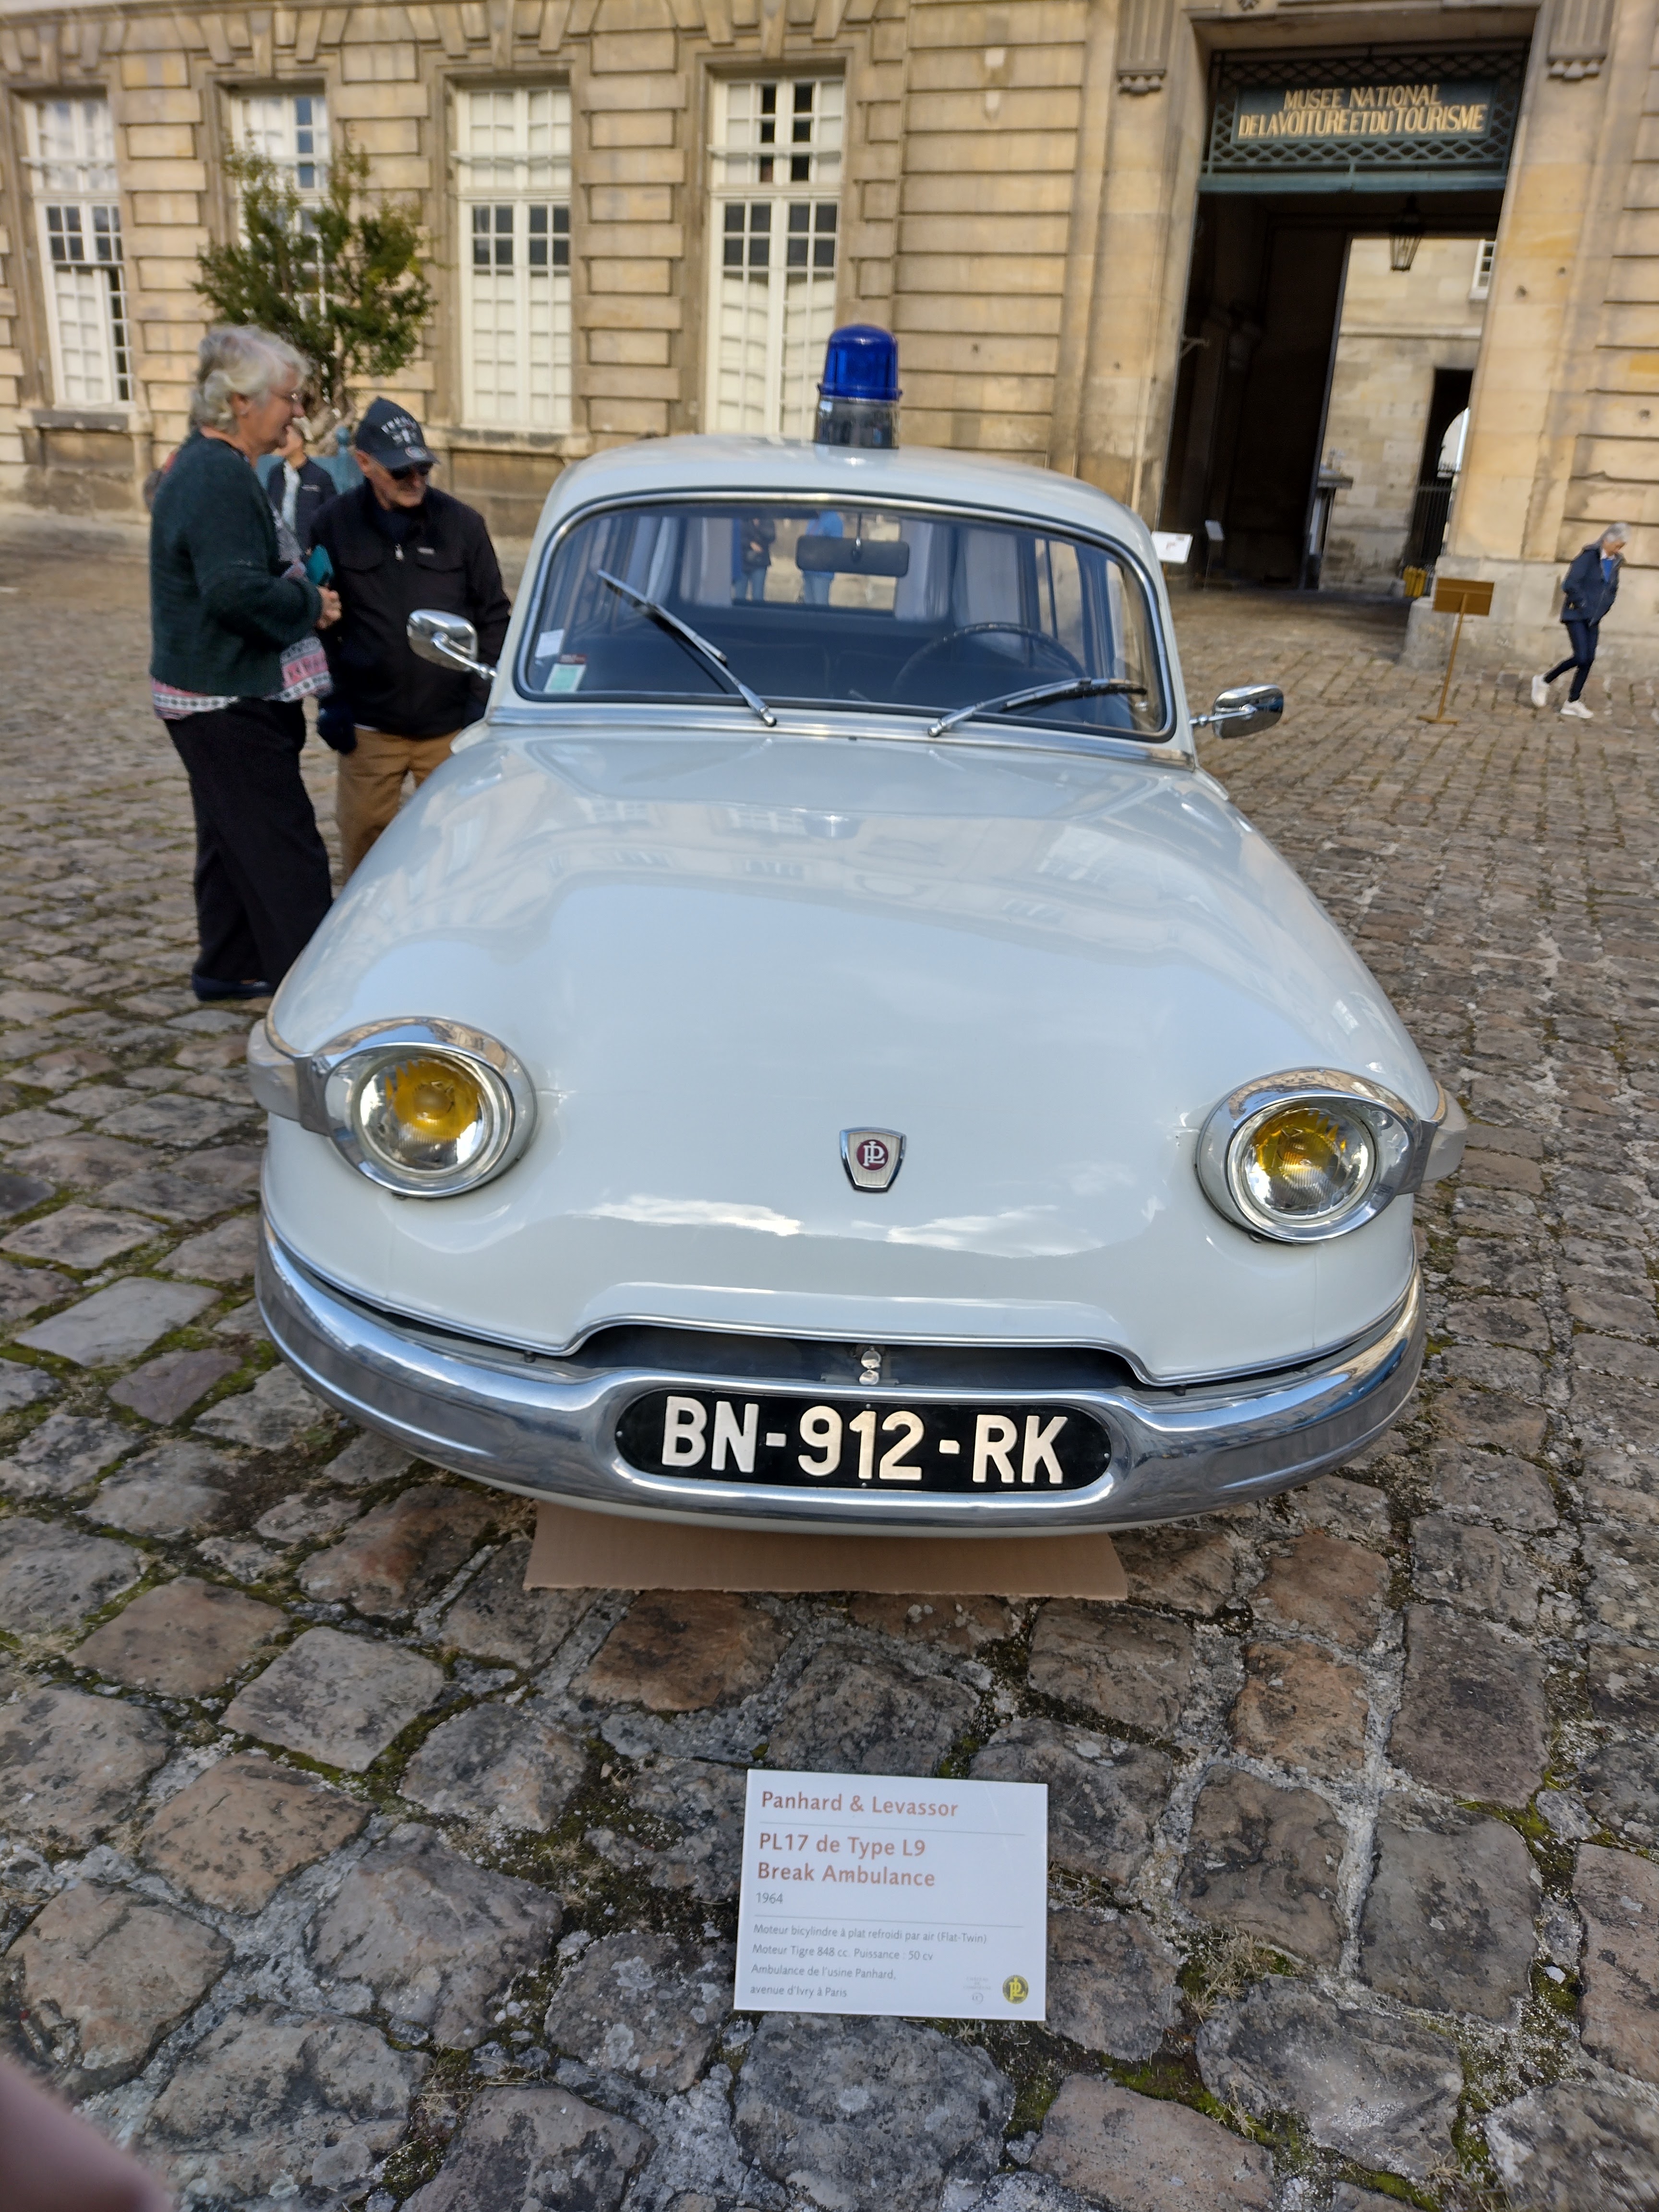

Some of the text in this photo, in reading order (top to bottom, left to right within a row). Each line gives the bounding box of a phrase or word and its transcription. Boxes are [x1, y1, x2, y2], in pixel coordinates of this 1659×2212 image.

[1284, 84, 1442, 111] MUSEE NATIONAL
[1278, 108, 1351, 138] VOITURE
[1395, 103, 1488, 134] TOURISME
[761, 1791, 958, 1816] Panhard & Levassor
[759, 1832, 926, 1860] PL17 de Type L9
[757, 1862, 936, 1887] Break Ambulance
[756, 1891, 784, 1904] 1964
[753, 1923, 987, 1944] Moteur bicylindre à plat refroidi par air (Flat-Twin)
[752, 1944, 787, 1955] Moteur
[791, 1945, 815, 1958] Tigre
[817, 1947, 835, 1957] 848
[854, 1948, 900, 1959] Puissance
[908, 1950, 920, 1960] 50
[923, 1952, 933, 1961] cv
[751, 1964, 805, 1975] Ambulance
[807, 1965, 819, 1976] de
[855, 1968, 896, 1980] Panhard,
[750, 1985, 784, 1995] avenue
[817, 1987, 822, 1996] à
[825, 1987, 847, 1997] Paris
